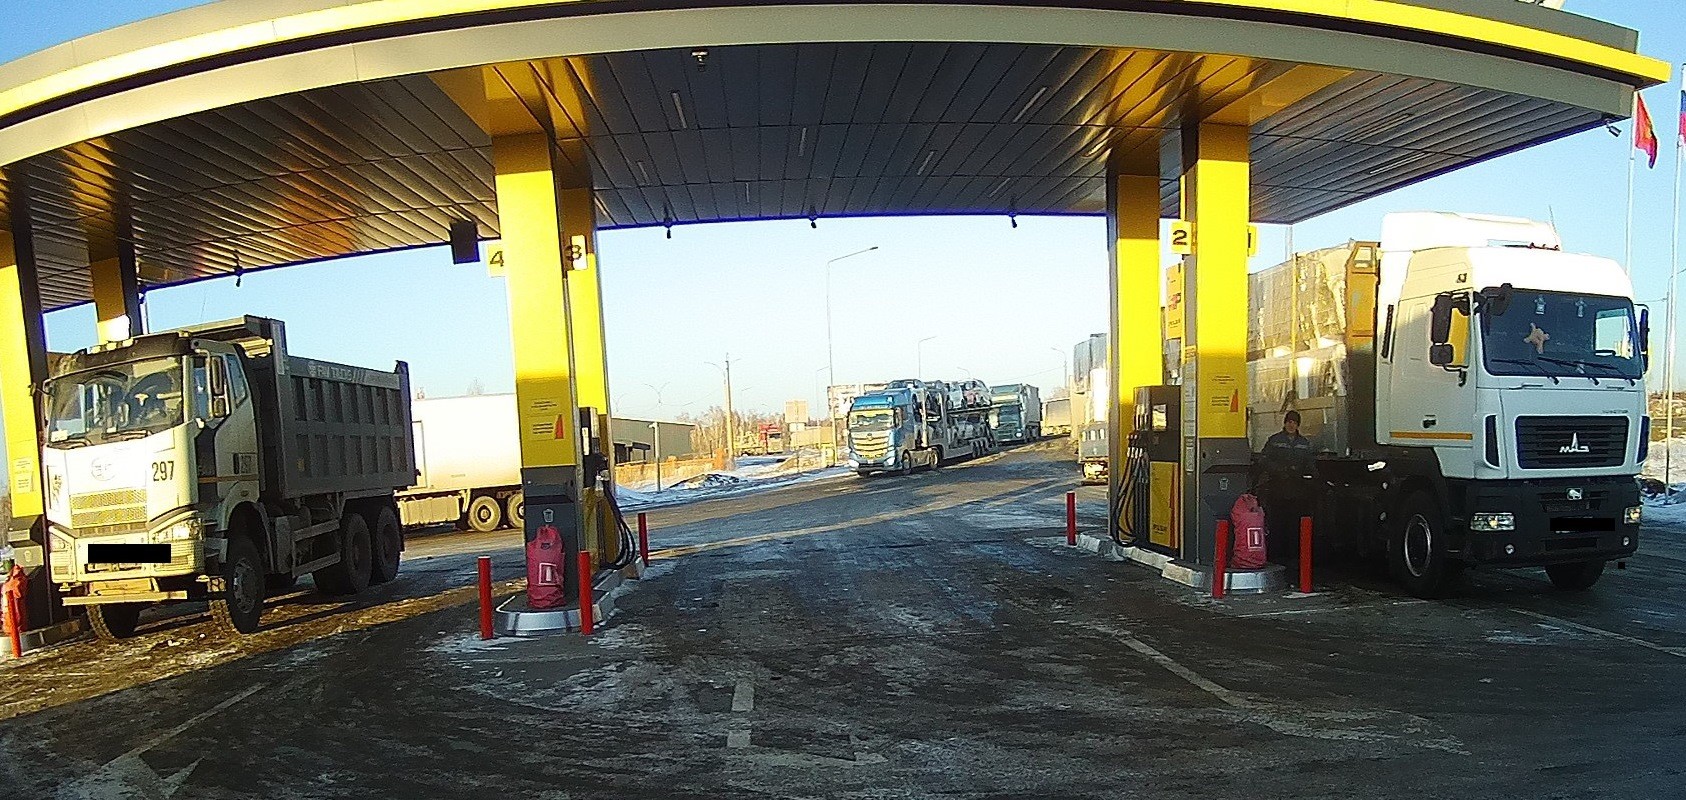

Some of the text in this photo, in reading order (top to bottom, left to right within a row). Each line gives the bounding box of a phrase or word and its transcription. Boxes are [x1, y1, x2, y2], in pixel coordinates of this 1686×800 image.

[1172, 229, 1187, 246] 2
[489, 250, 504, 267] 4
[563, 244, 582, 262] 3
[151, 460, 175, 482] 297
